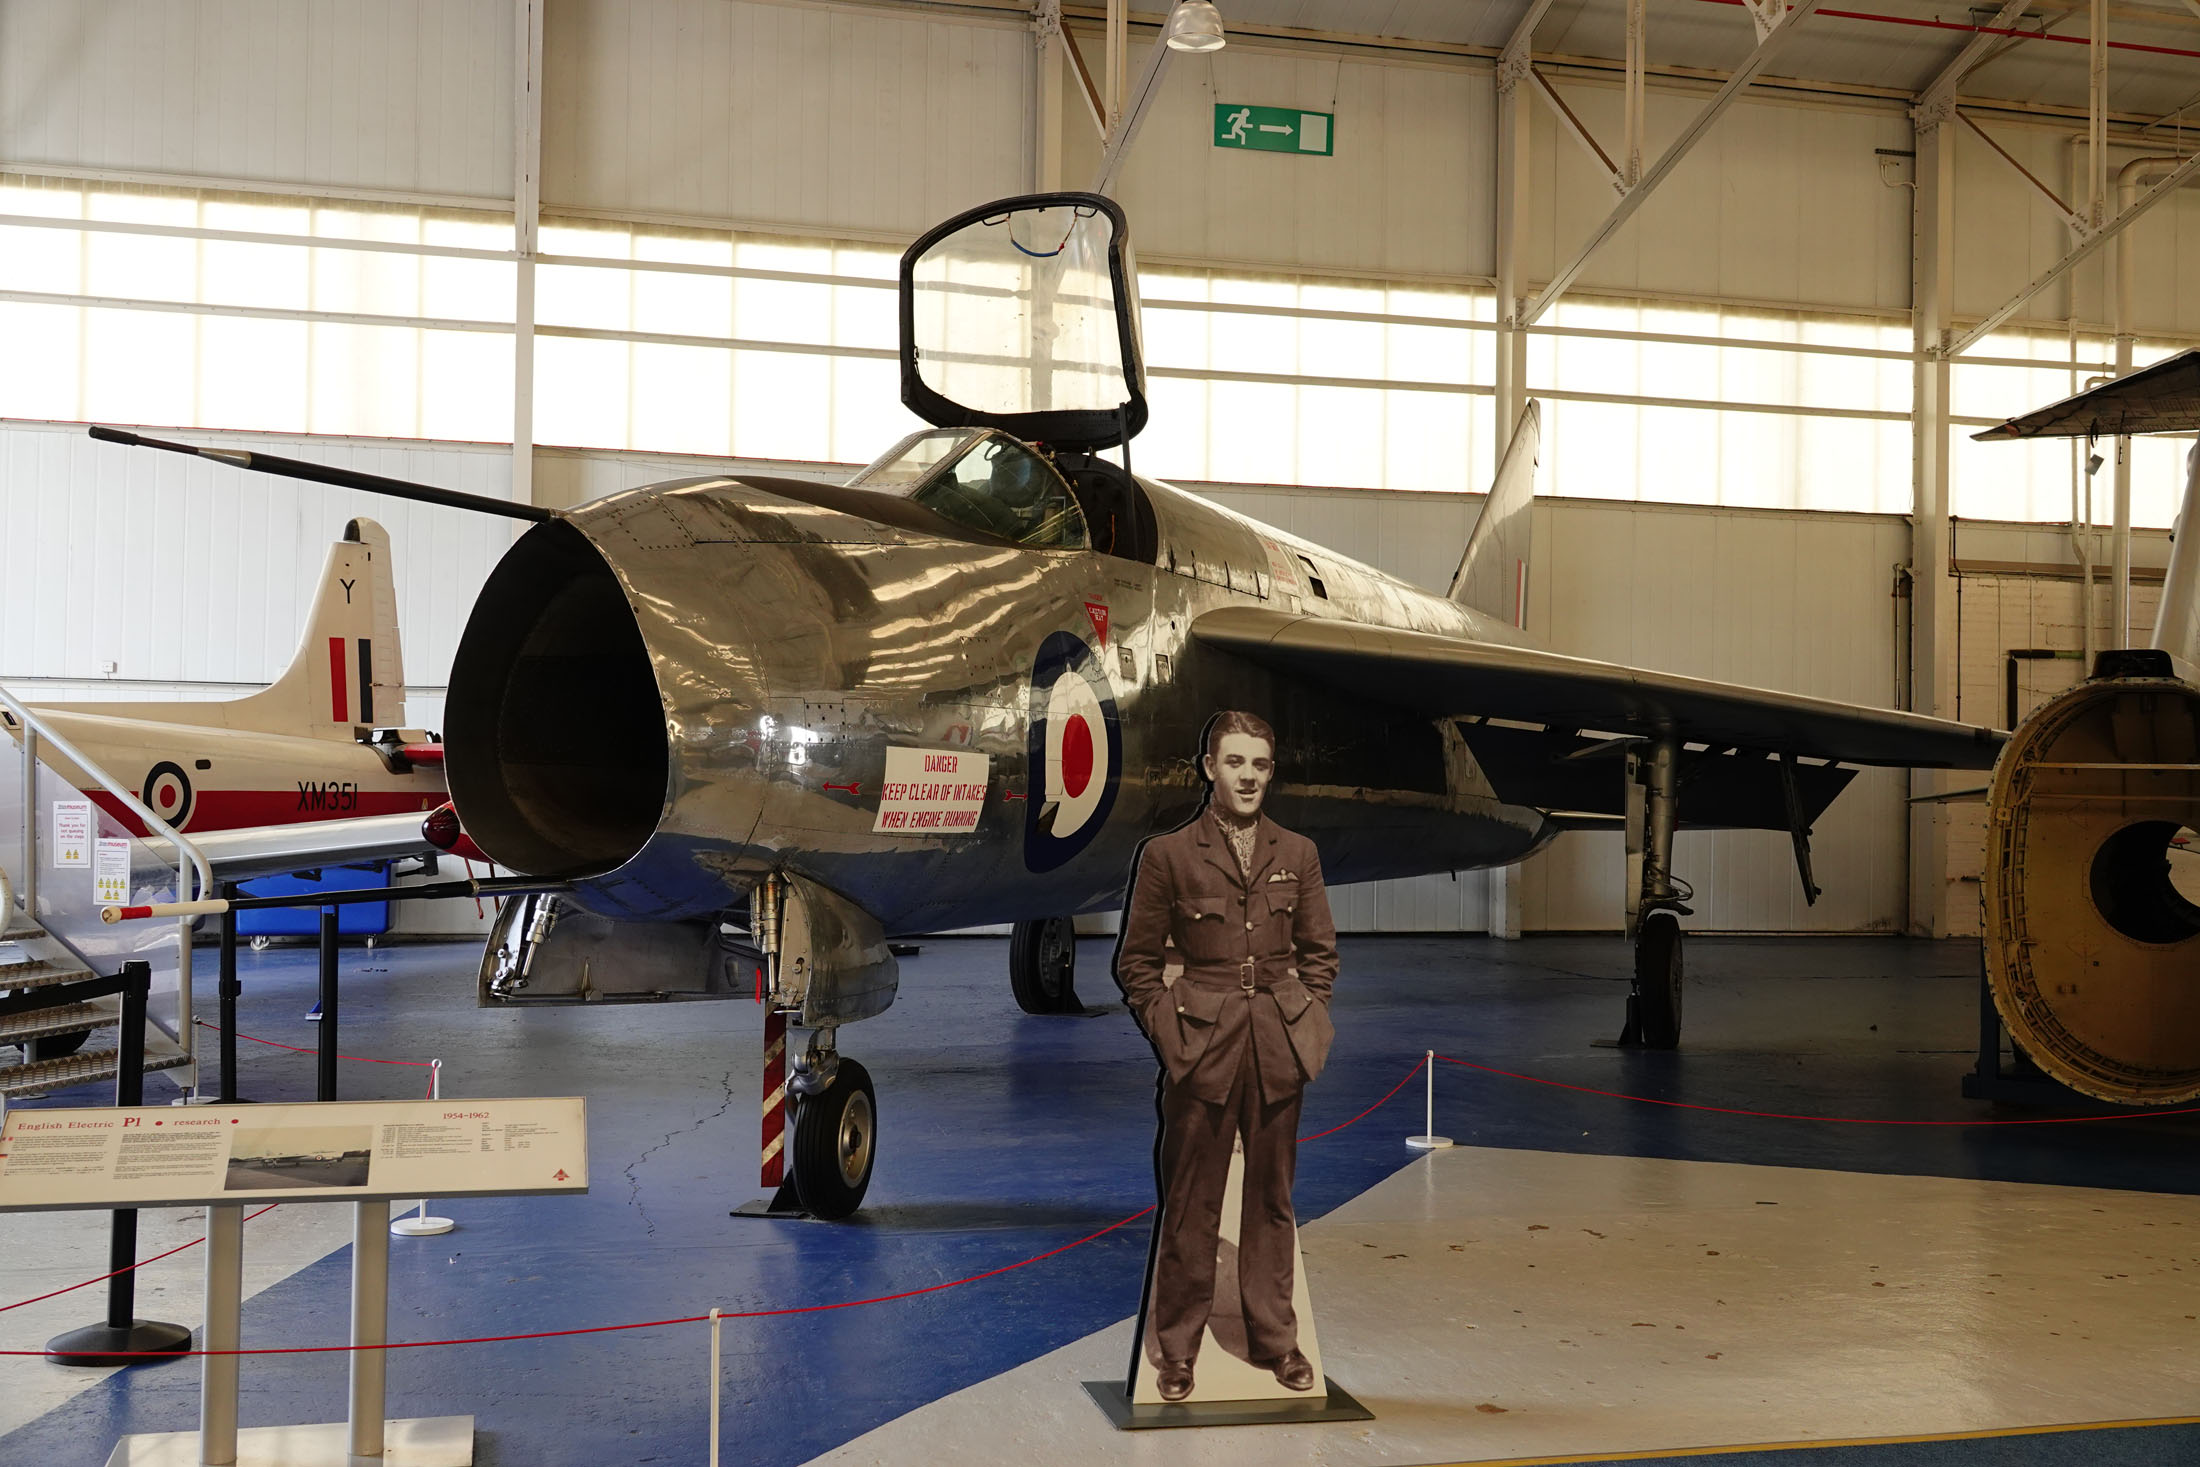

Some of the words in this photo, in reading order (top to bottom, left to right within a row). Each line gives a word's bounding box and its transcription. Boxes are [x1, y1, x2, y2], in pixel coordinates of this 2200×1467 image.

[339, 578, 356, 604] Y
[924, 754, 958, 773] DANGER
[297, 780, 358, 811] XM351
[881, 782, 908, 801] KEEP
[908, 783, 940, 801] CLEAR
[940, 784, 953, 801] OF
[953, 783, 988, 801] INTAKES
[881, 811, 909, 828] WHEN
[909, 811, 944, 828] ENGINE
[942, 810, 978, 827] RUNNING
[18, 1122, 62, 1131] English
[68, 1121, 114, 1129] Electric
[174, 1118, 221, 1126] research
[443, 1112, 489, 1120] 1954-1962
